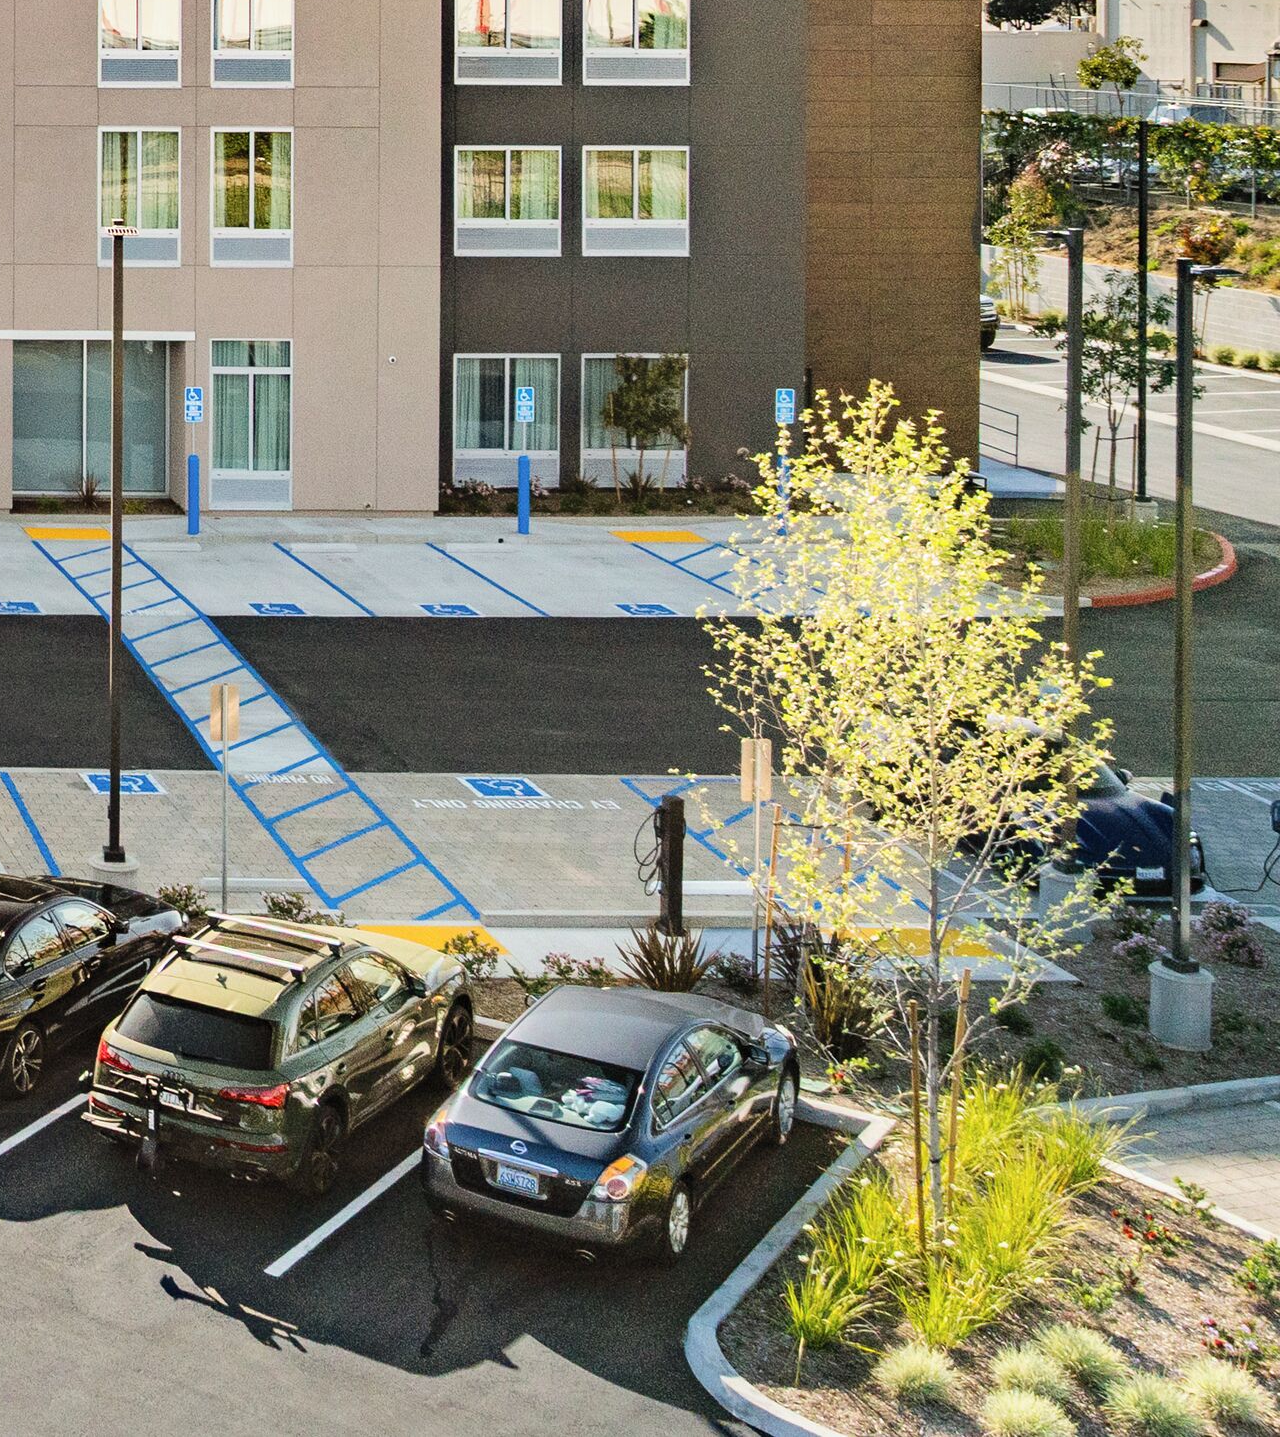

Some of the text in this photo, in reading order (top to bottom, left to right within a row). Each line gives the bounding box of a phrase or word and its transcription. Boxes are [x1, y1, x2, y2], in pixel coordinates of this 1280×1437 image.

[244, 773, 334, 784] NO PARKING
[411, 798, 621, 810] EV CHARGING ONLY
